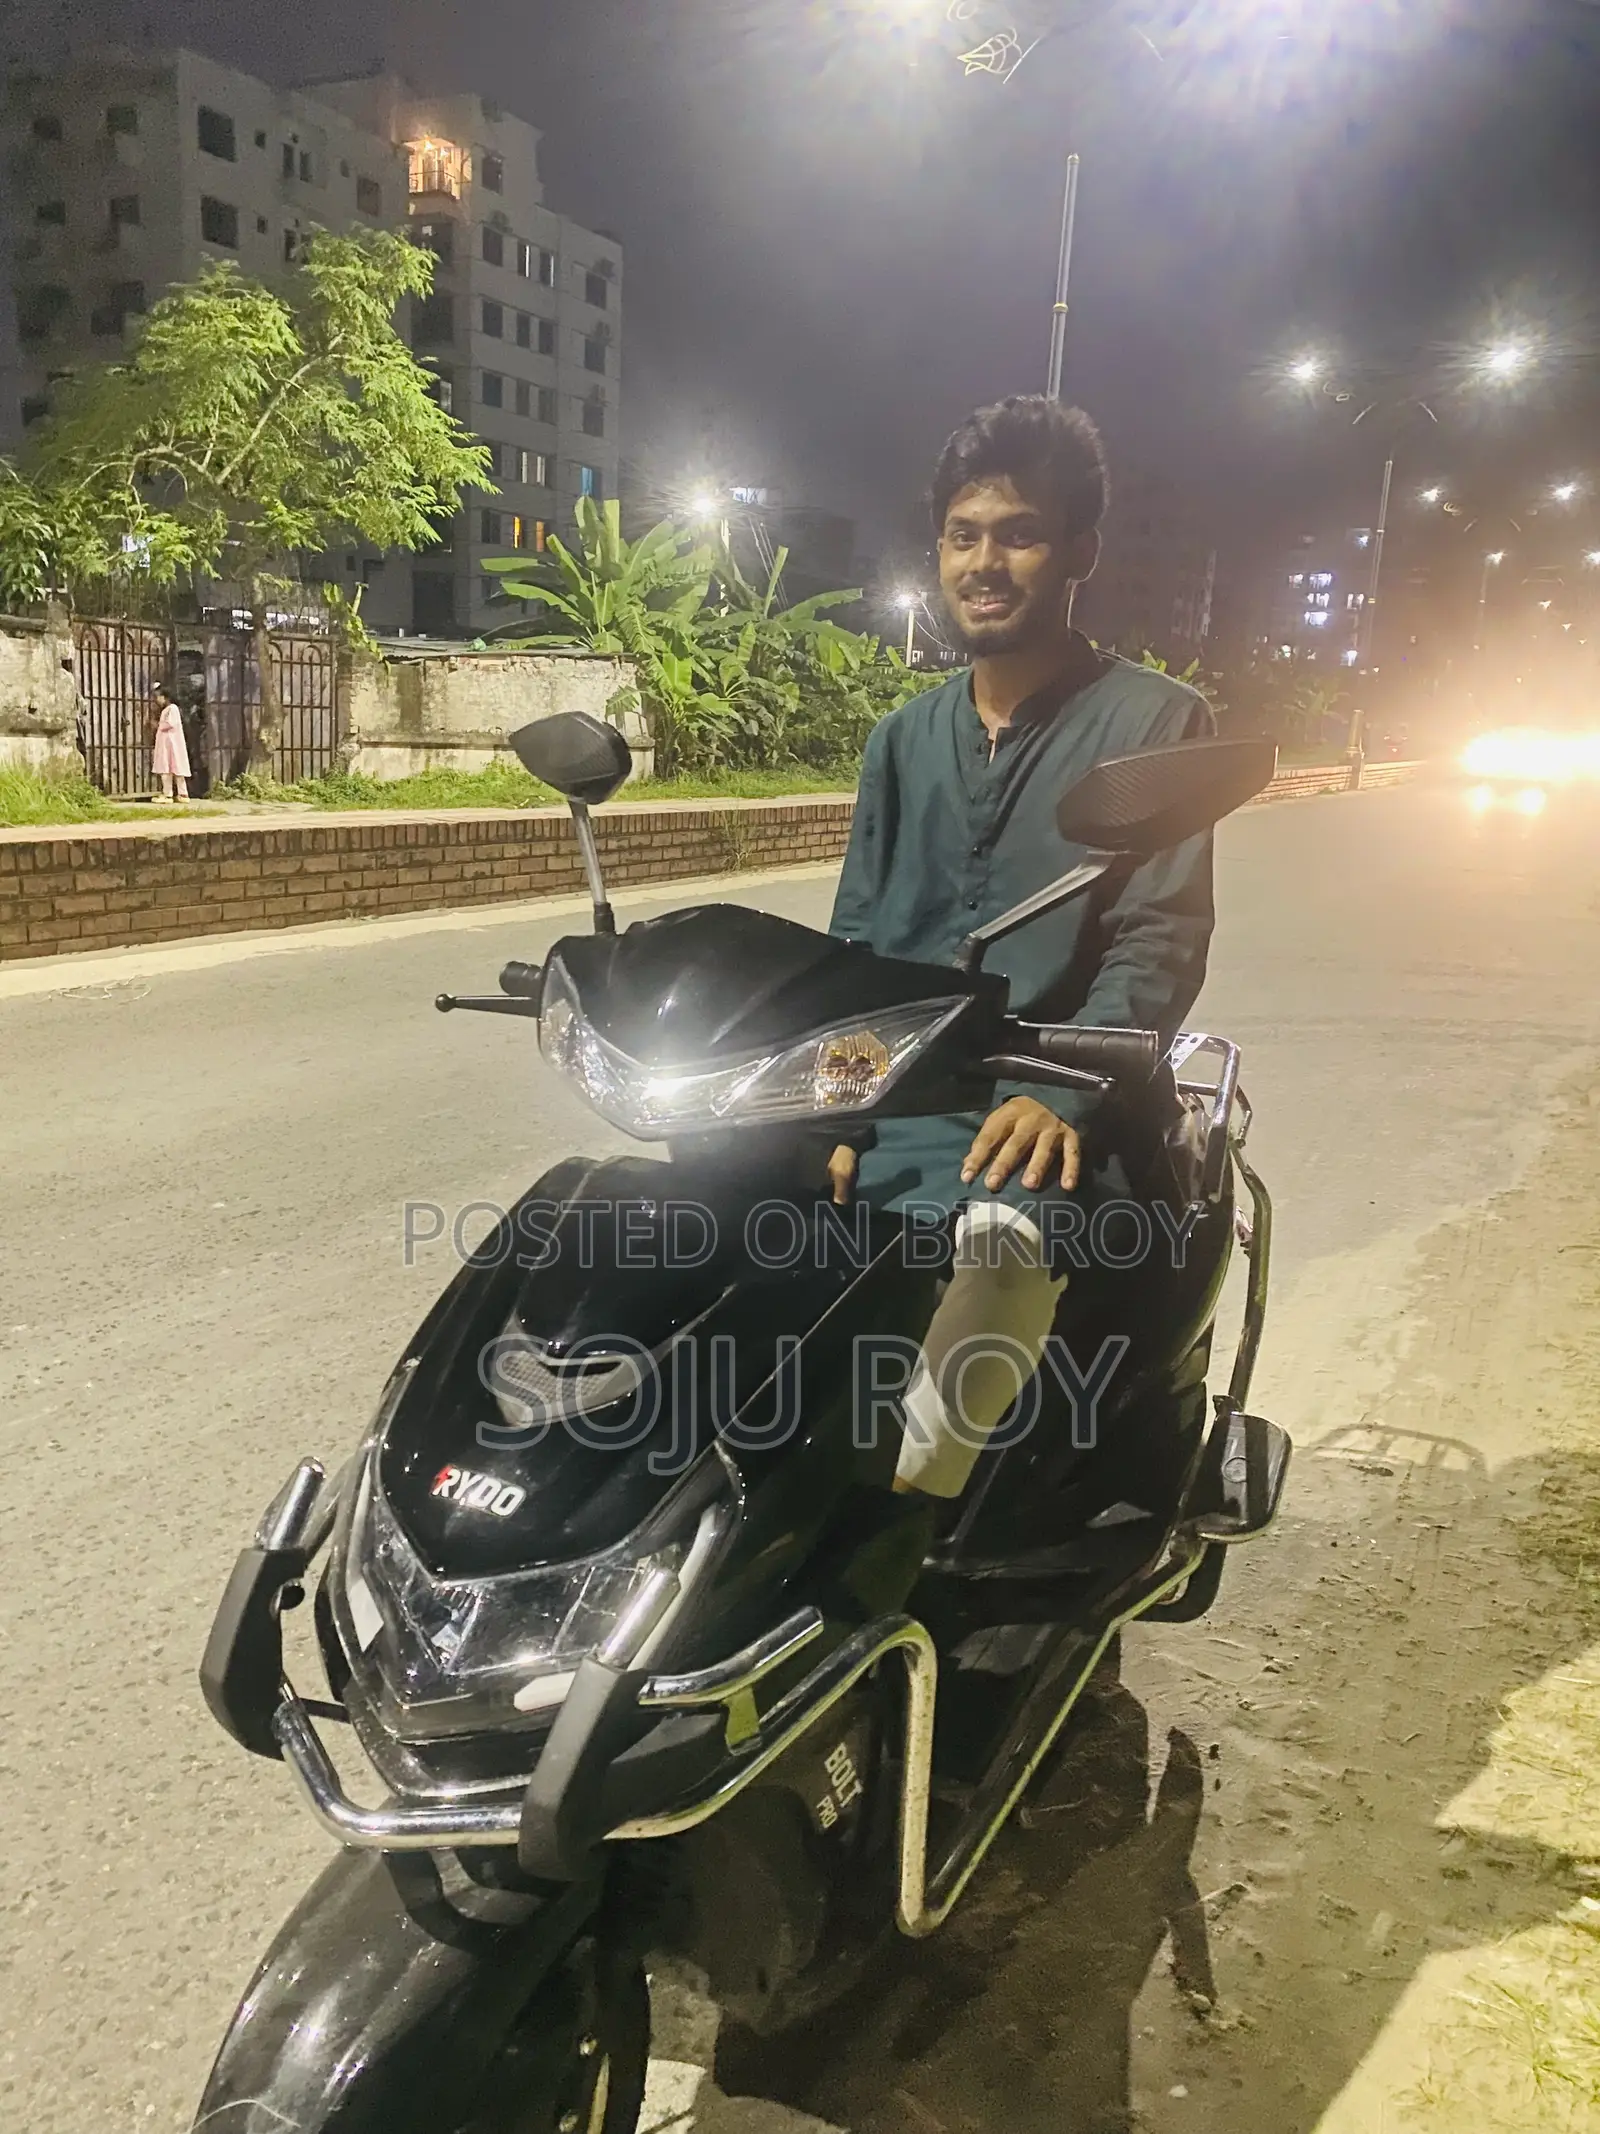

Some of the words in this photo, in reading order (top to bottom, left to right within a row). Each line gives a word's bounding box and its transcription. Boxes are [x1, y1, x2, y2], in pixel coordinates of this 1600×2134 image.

[430, 1464, 526, 1517] RYDO
[824, 1742, 863, 1808] BOLT
[816, 1795, 838, 1829] PRO
